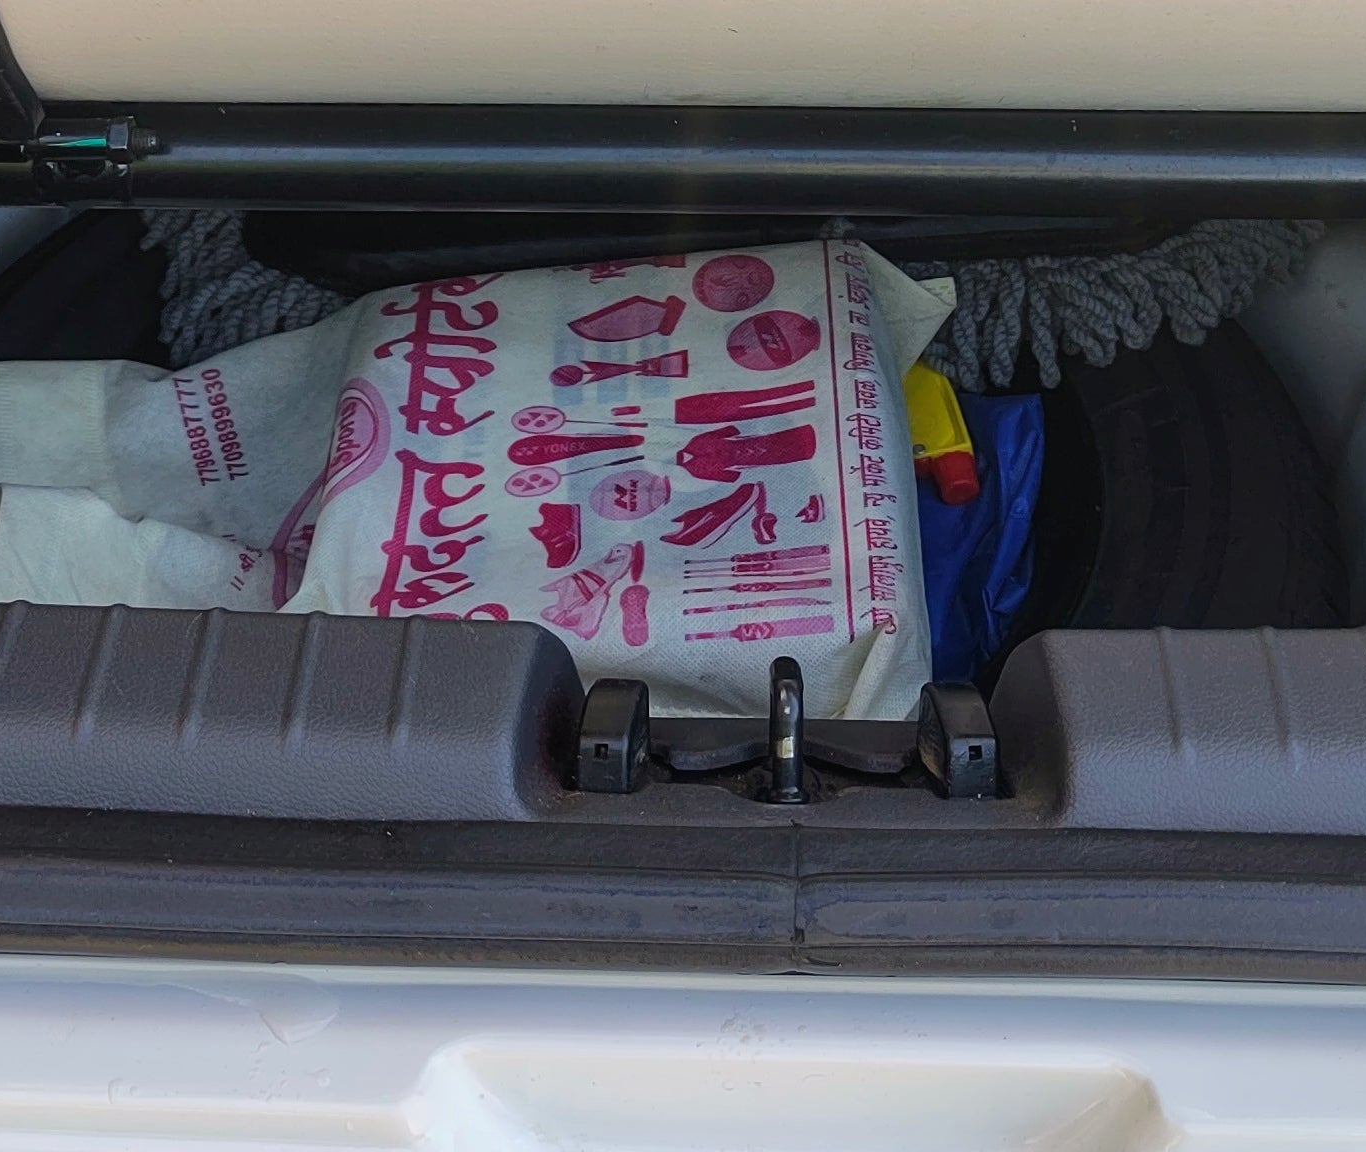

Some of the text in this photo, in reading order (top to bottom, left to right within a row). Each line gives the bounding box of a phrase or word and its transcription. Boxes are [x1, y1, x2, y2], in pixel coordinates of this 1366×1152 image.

[173, 376, 221, 486] 7796887777
[201, 368, 250, 480] 7709899630
[330, 400, 360, 469] Sports
[542, 441, 586, 454] YONEX
